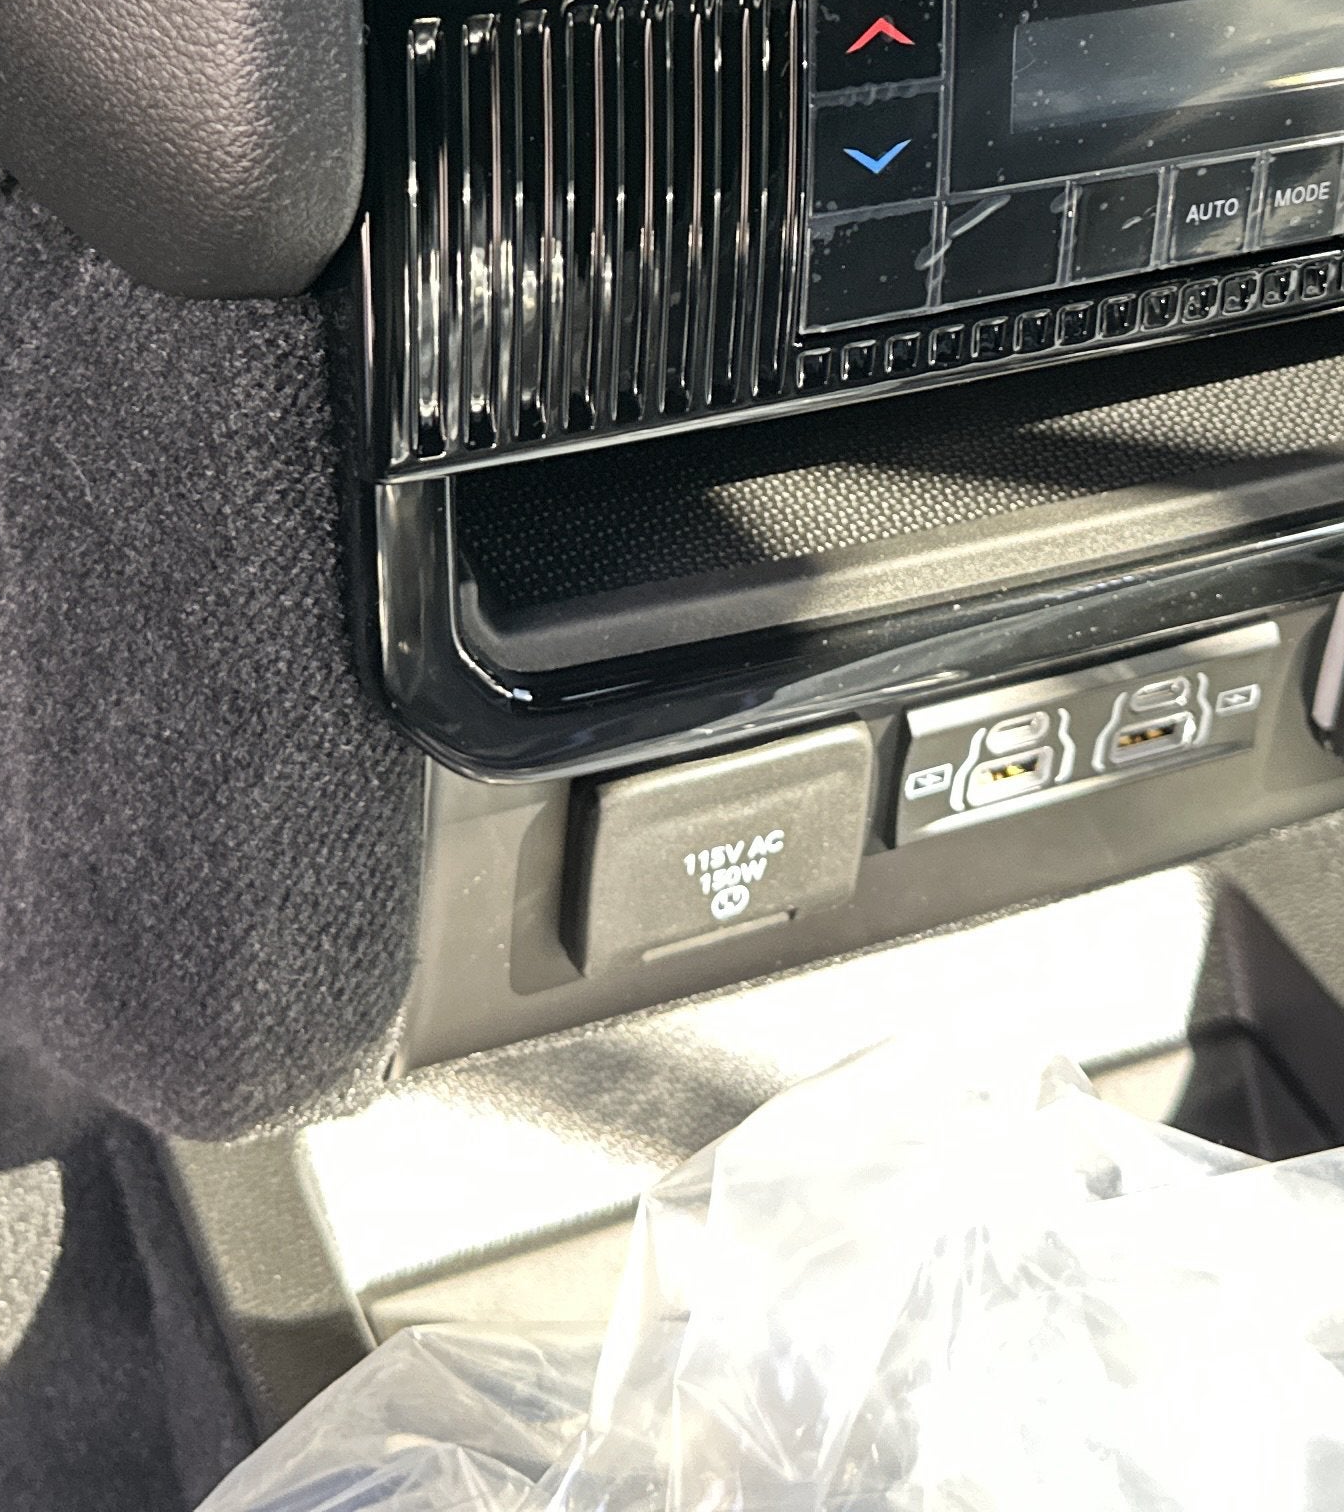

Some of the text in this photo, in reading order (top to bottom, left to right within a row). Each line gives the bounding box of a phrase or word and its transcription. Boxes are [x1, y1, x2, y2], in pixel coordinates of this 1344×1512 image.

[1185, 197, 1240, 224] AUTO
[1274, 181, 1332, 208] MODE
[683, 829, 785, 876] 115V AC
[699, 857, 768, 895] 150W
